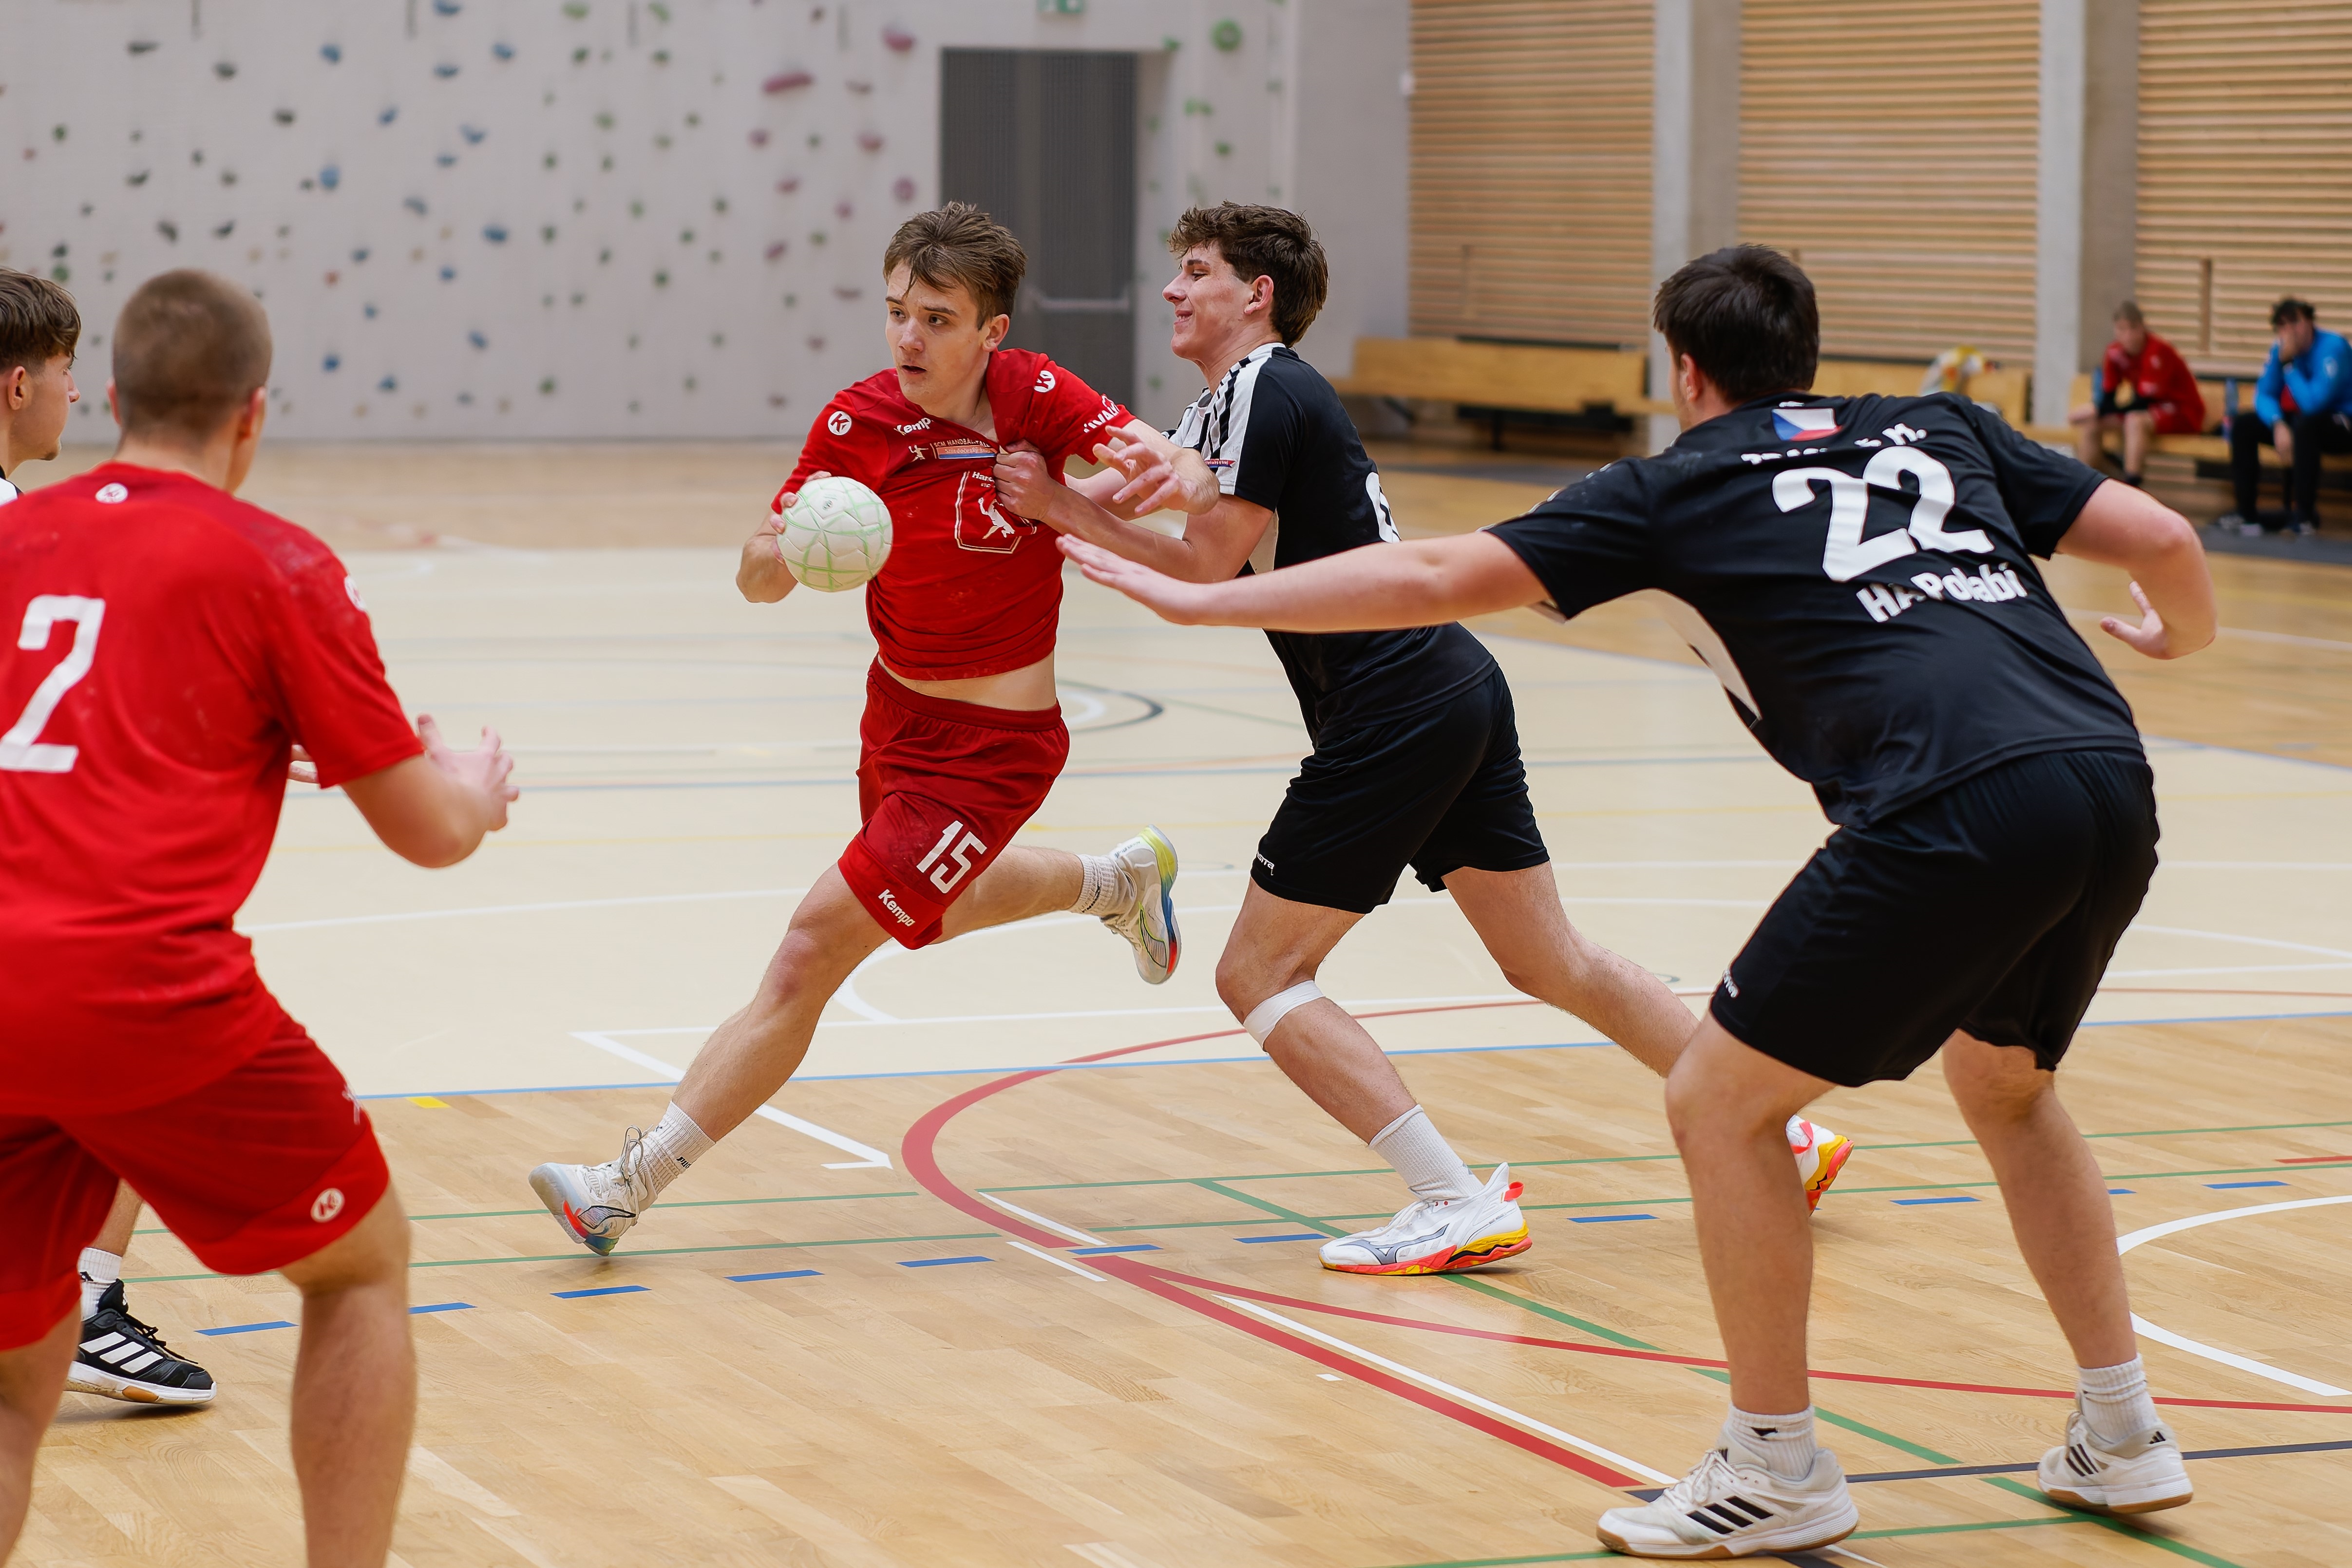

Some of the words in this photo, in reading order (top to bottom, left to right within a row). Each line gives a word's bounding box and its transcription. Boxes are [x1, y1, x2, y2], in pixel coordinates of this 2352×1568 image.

[893, 417, 934, 436] Kemp
[1772, 445, 1996, 582] 22
[0, 595, 106, 773] 2
[916, 820, 987, 894] 15
[878, 888, 915, 927] Kempa
